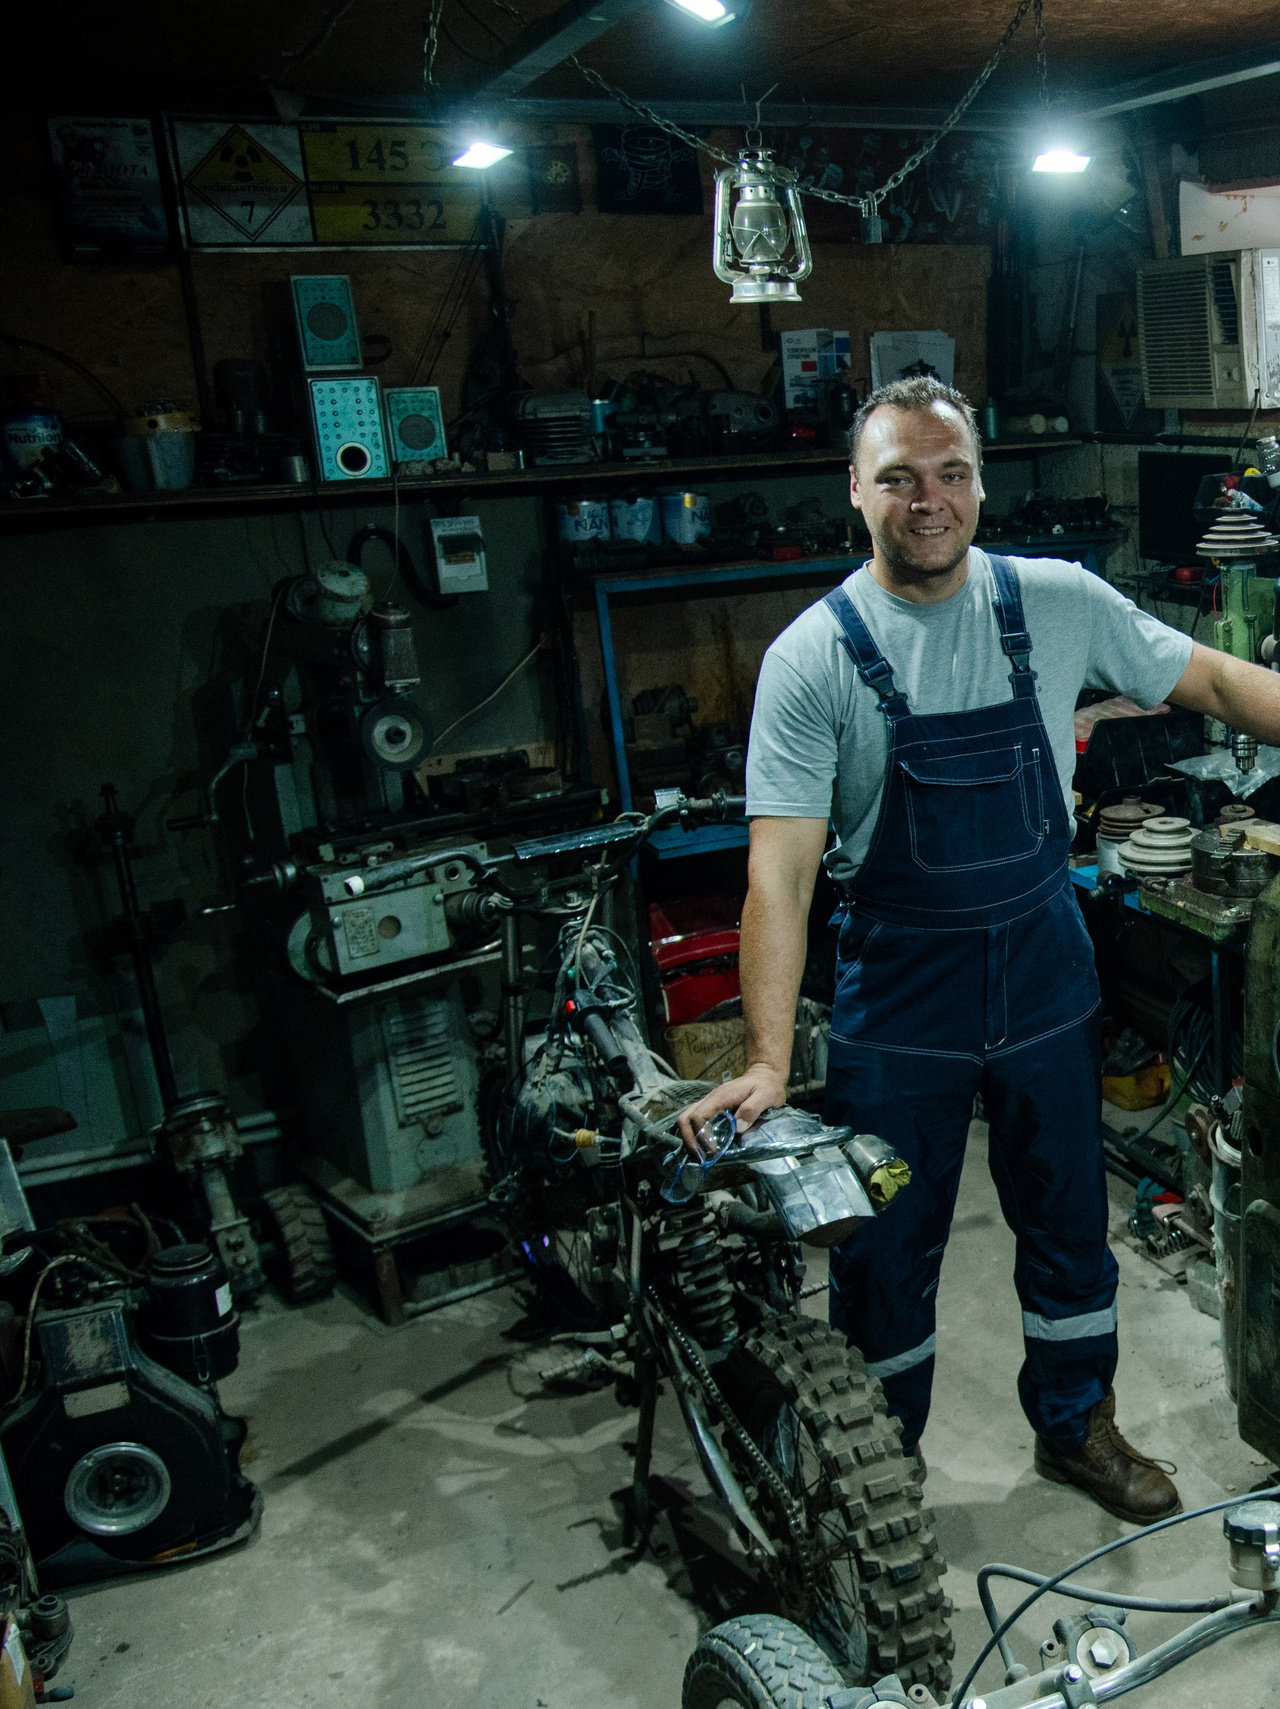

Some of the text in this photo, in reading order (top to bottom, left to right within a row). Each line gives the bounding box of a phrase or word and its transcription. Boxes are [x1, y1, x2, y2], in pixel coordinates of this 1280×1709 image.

[345, 140, 409, 172] 145
[241, 201, 254, 223] 7
[362, 200, 446, 230] 3332
[8, 433, 60, 443] Nutrilon
